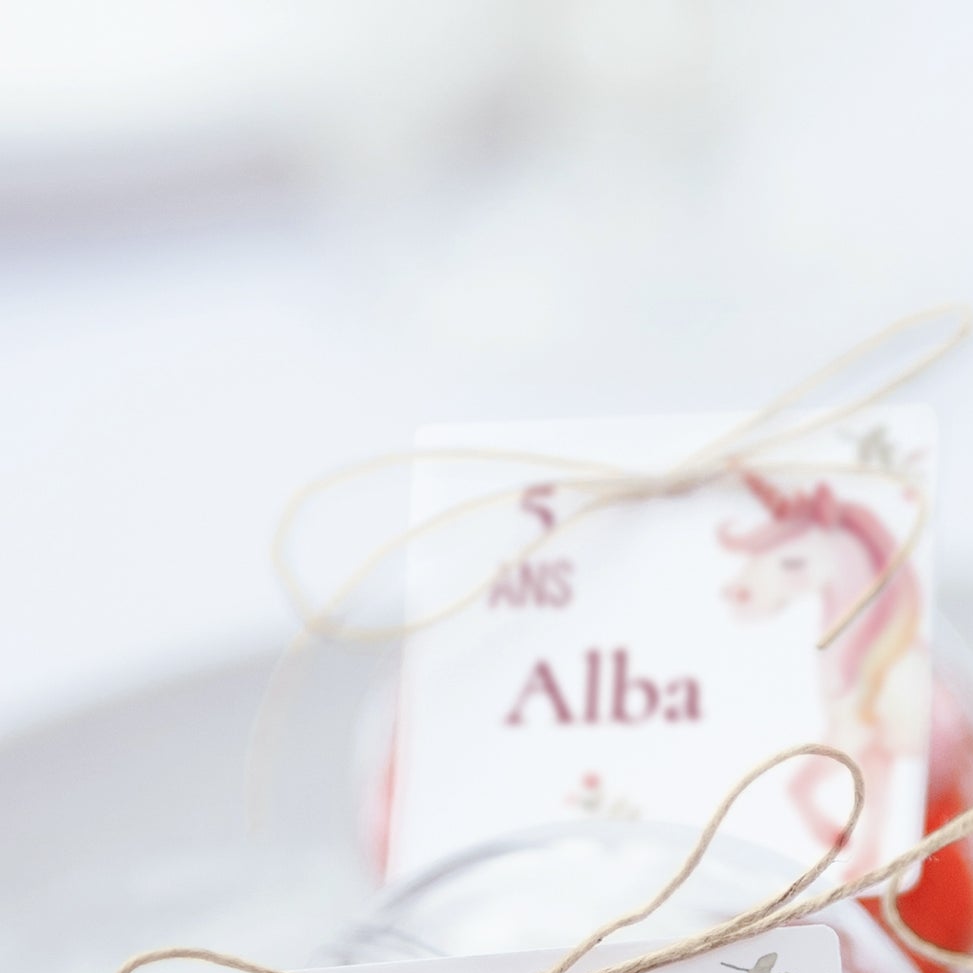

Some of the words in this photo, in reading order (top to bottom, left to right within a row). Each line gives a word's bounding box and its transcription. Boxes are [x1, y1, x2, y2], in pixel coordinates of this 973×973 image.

[517, 481, 556, 536] 5
[488, 558, 574, 609] ANS
[503, 645, 704, 727] Alba
